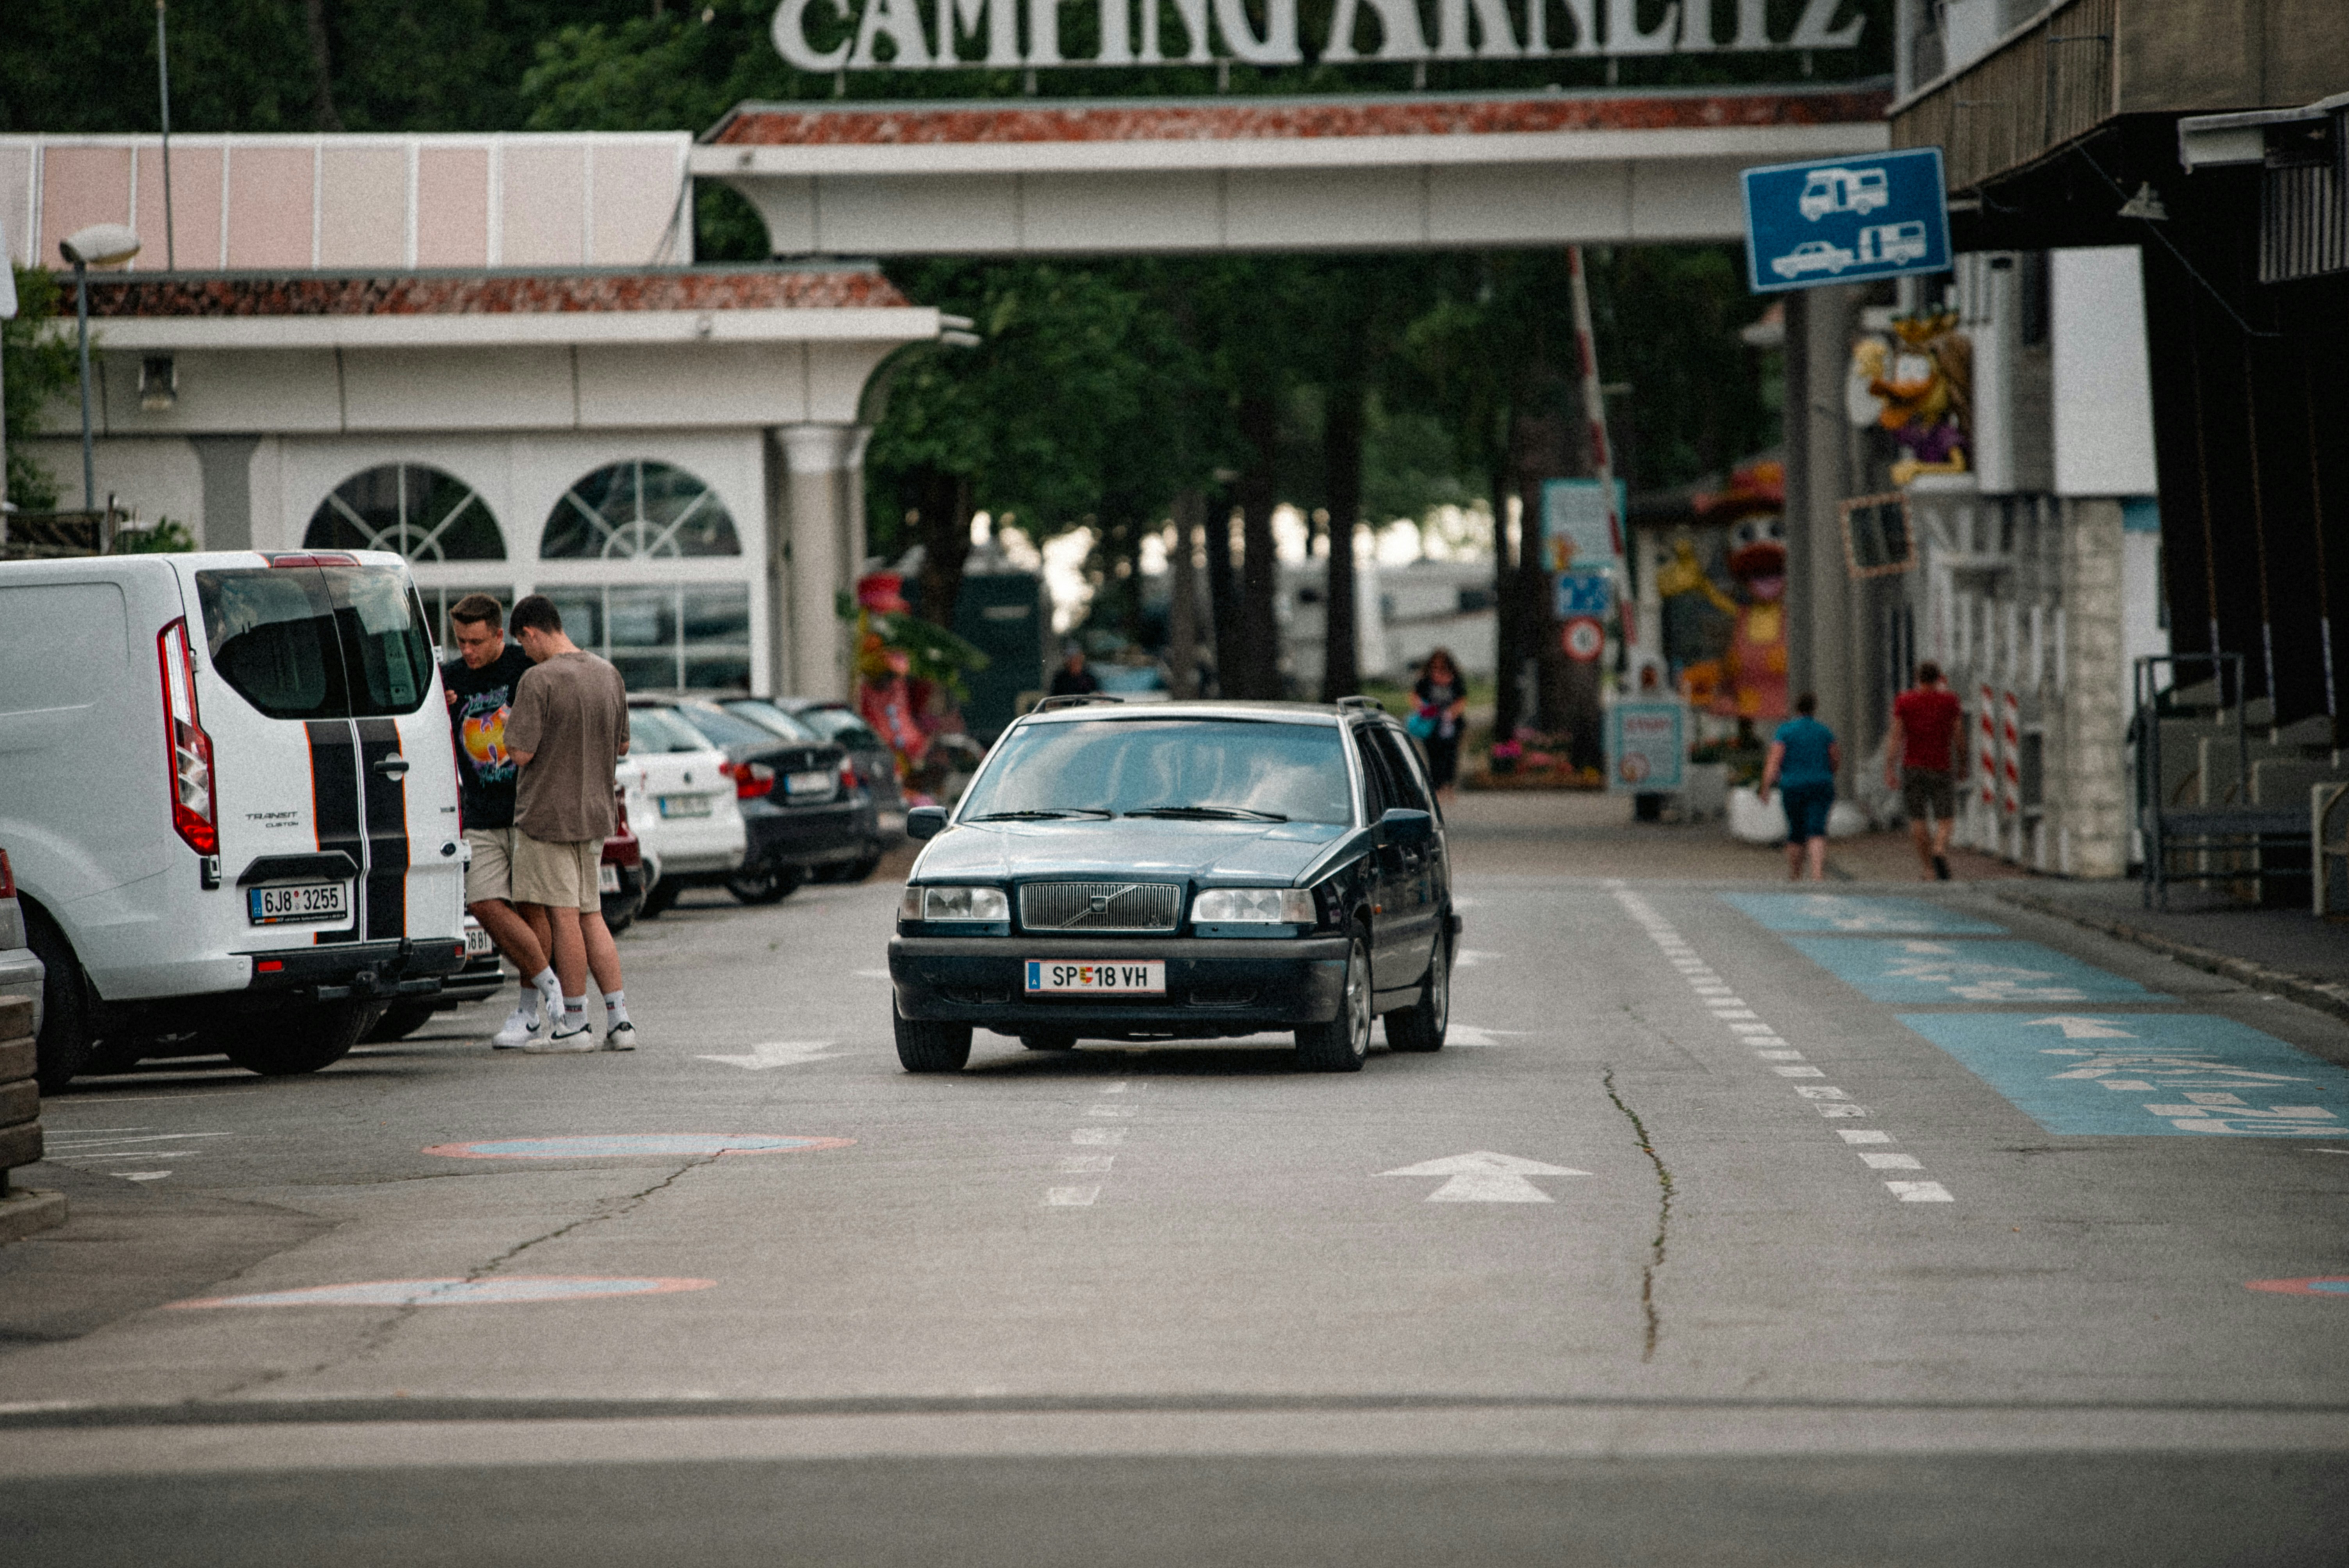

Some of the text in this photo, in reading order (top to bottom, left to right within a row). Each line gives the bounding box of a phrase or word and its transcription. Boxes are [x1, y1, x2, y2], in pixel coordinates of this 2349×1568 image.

[245, 811, 298, 820] TRANSIT
[264, 887, 339, 913] 6J8 3255
[1053, 966, 1147, 987] SP 18 VH
